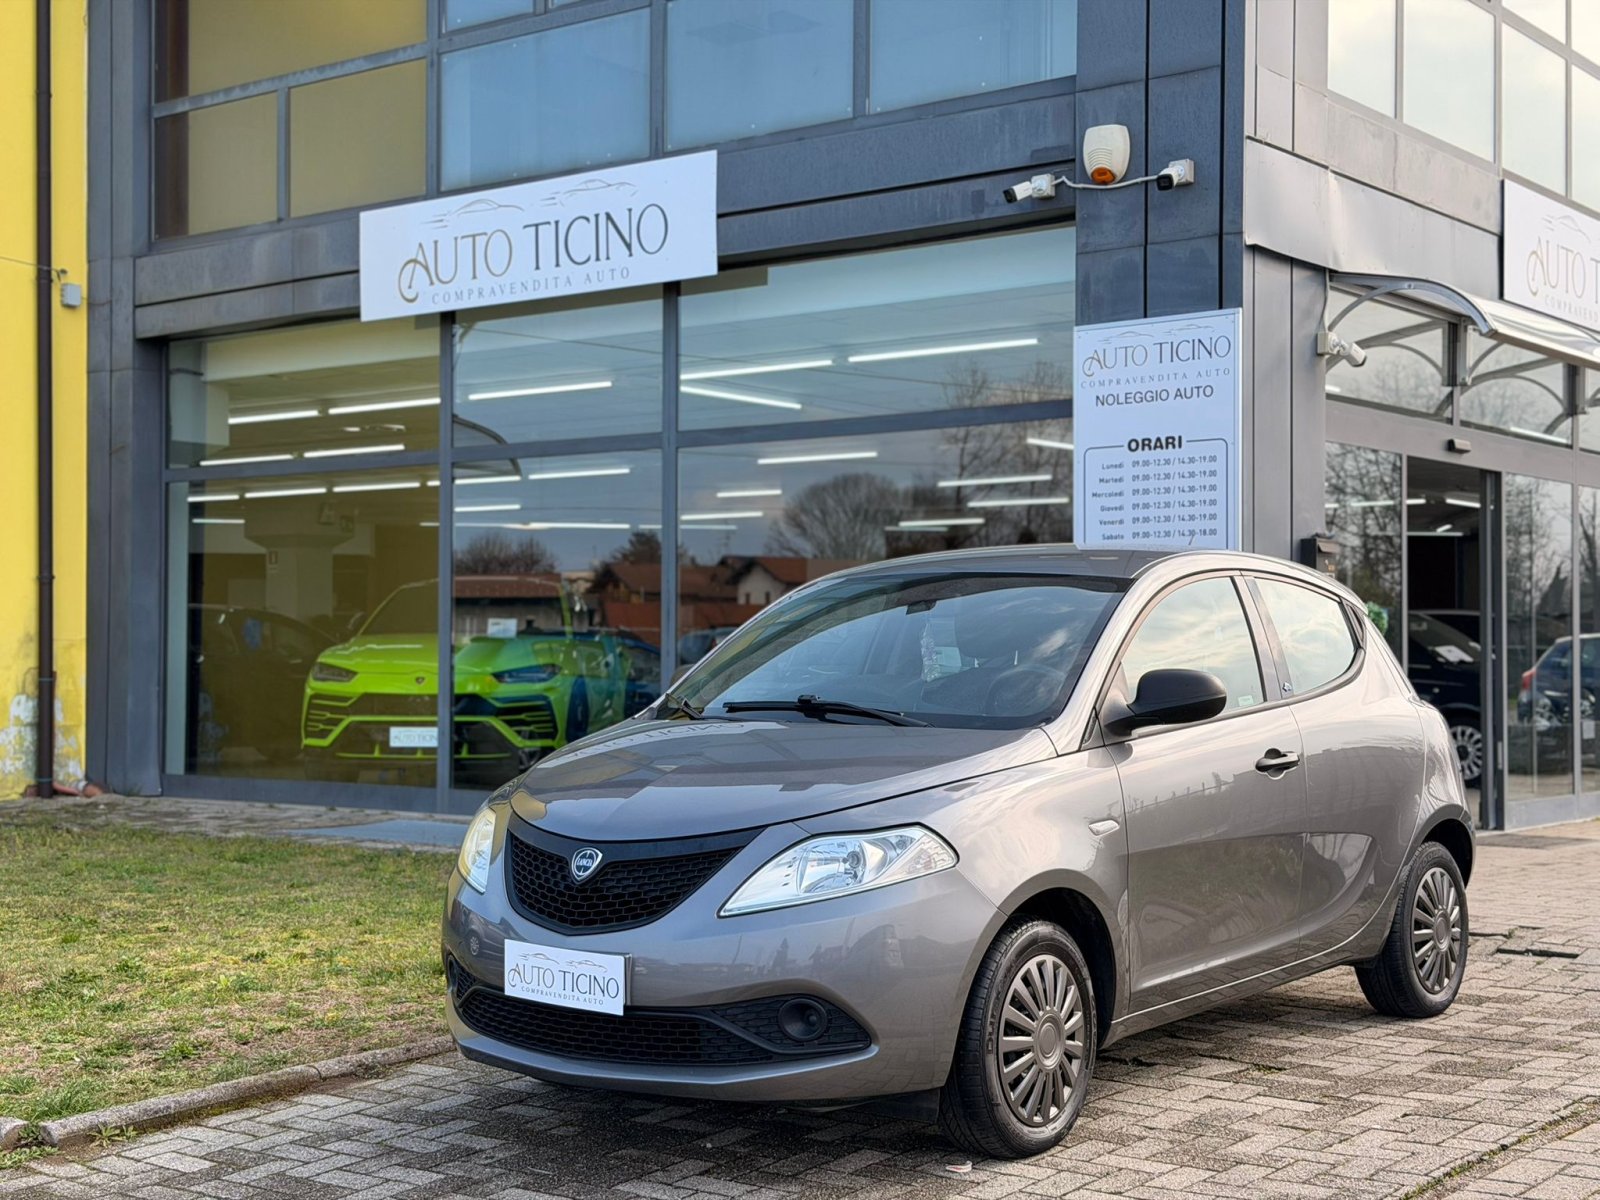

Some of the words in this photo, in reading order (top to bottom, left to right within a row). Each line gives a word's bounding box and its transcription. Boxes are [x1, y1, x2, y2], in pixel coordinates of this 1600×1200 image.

[398, 229, 513, 303] AUTO
[523, 203, 668, 271] TICINO
[1527, 236, 1586, 299] AUTO
[432, 275, 573, 305] COMPRAVENDITA
[584, 266, 631, 285] AUTO
[1082, 344, 1148, 377] AUTO
[1153, 335, 1231, 364] TICINO
[1081, 372, 1188, 389] COMPRAVENDITA
[1196, 367, 1230, 379] AUTO
[1095, 388, 1169, 407] NOLEGGIO
[1174, 385, 1214, 401] AUTO
[1127, 435, 1182, 452] ORARI
[508, 963, 555, 989] AUTO
[558, 969, 619, 999] TICINO
[520, 986, 580, 1001] COMPRAVENDITA
[583, 996, 604, 1005] AUTO
